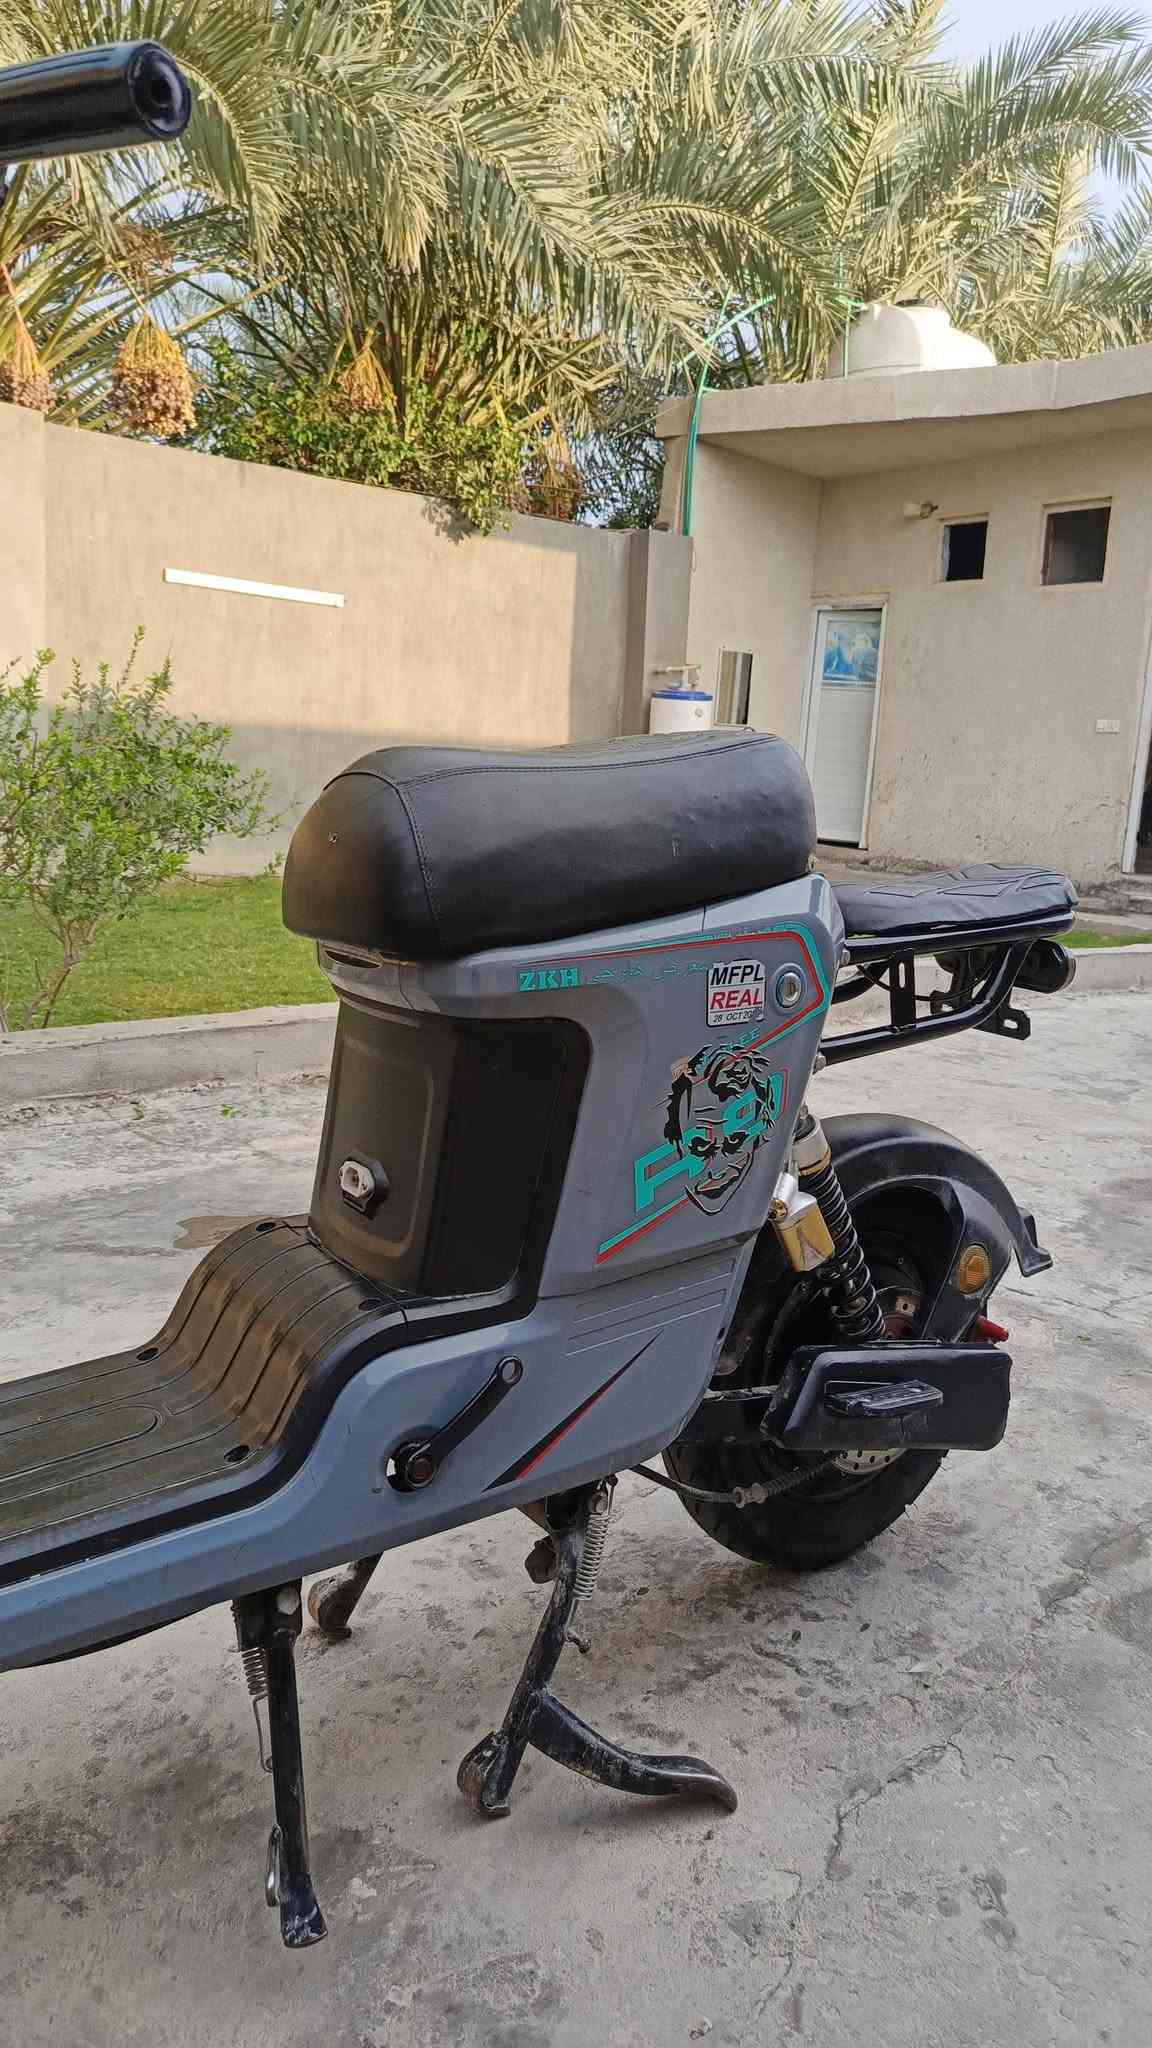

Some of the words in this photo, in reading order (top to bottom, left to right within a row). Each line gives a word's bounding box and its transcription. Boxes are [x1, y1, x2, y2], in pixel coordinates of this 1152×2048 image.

[519, 967, 579, 993] ZKH
[710, 963, 764, 987] MFPL
[710, 988, 763, 1010] REAL
